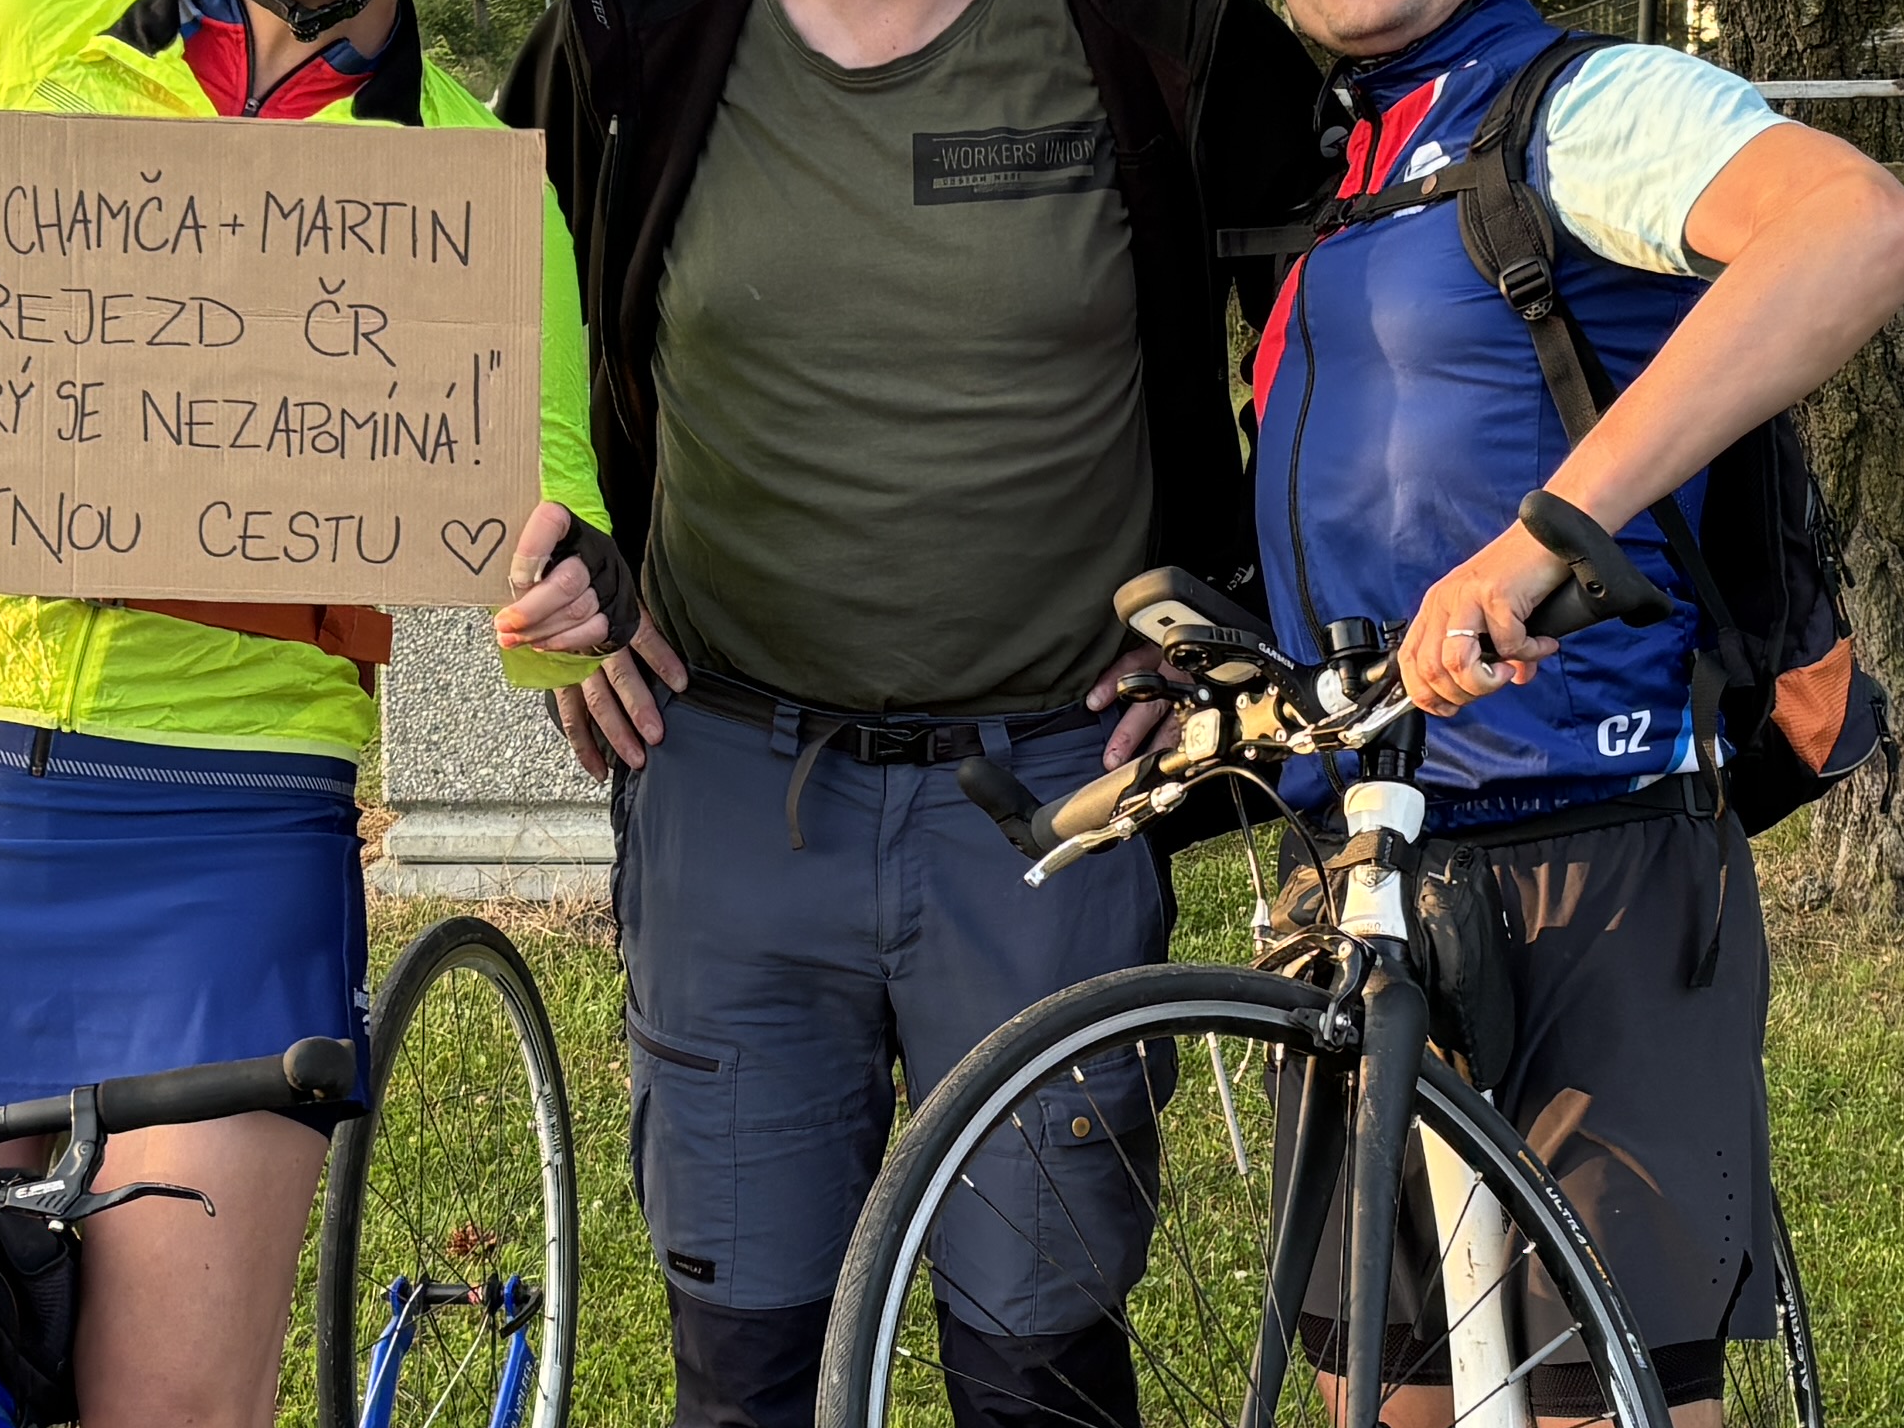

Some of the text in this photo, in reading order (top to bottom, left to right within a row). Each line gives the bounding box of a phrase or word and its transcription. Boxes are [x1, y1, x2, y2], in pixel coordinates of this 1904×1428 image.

[3, 169, 207, 257] CHAMČA
[261, 189, 471, 267] MARTIN
[304, 276, 398, 368] ČR
[56, 378, 106, 443] SE
[197, 498, 401, 565] CESTU
[1597, 709, 1651, 757] CZ
[1545, 1186, 1588, 1246] ULTRA
